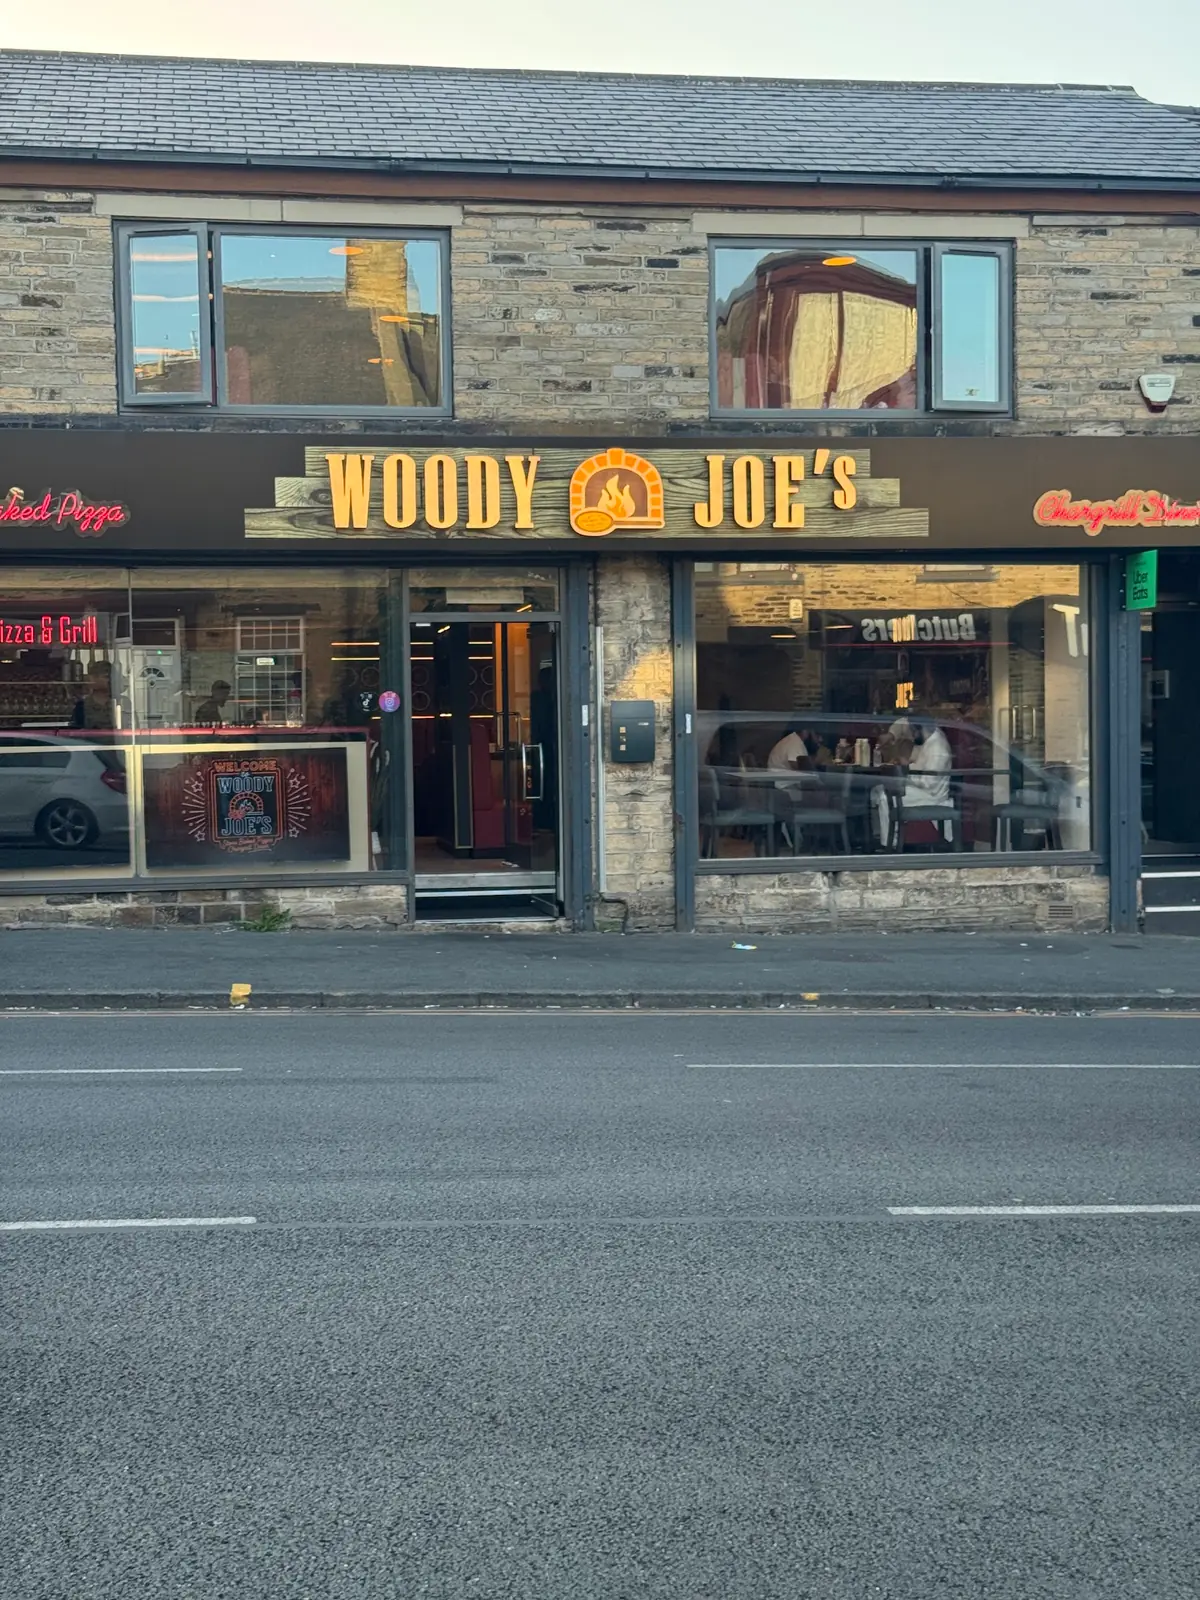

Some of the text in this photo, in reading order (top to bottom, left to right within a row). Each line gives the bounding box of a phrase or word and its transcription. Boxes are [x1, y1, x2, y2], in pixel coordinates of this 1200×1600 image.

[325, 448, 857, 529] WOODY JOE'S
[57, 493, 125, 531] Pizza
[1038, 495, 1141, 529] Chargrill
[1132, 570, 1148, 584] Uber
[1132, 586, 1148, 600] Eats
[41, 616, 53, 644] &
[59, 616, 97, 644] Grill
[215, 761, 277, 772] WELCOME
[217, 776, 274, 793] WOODY
[221, 816, 272, 836] JOE'S
